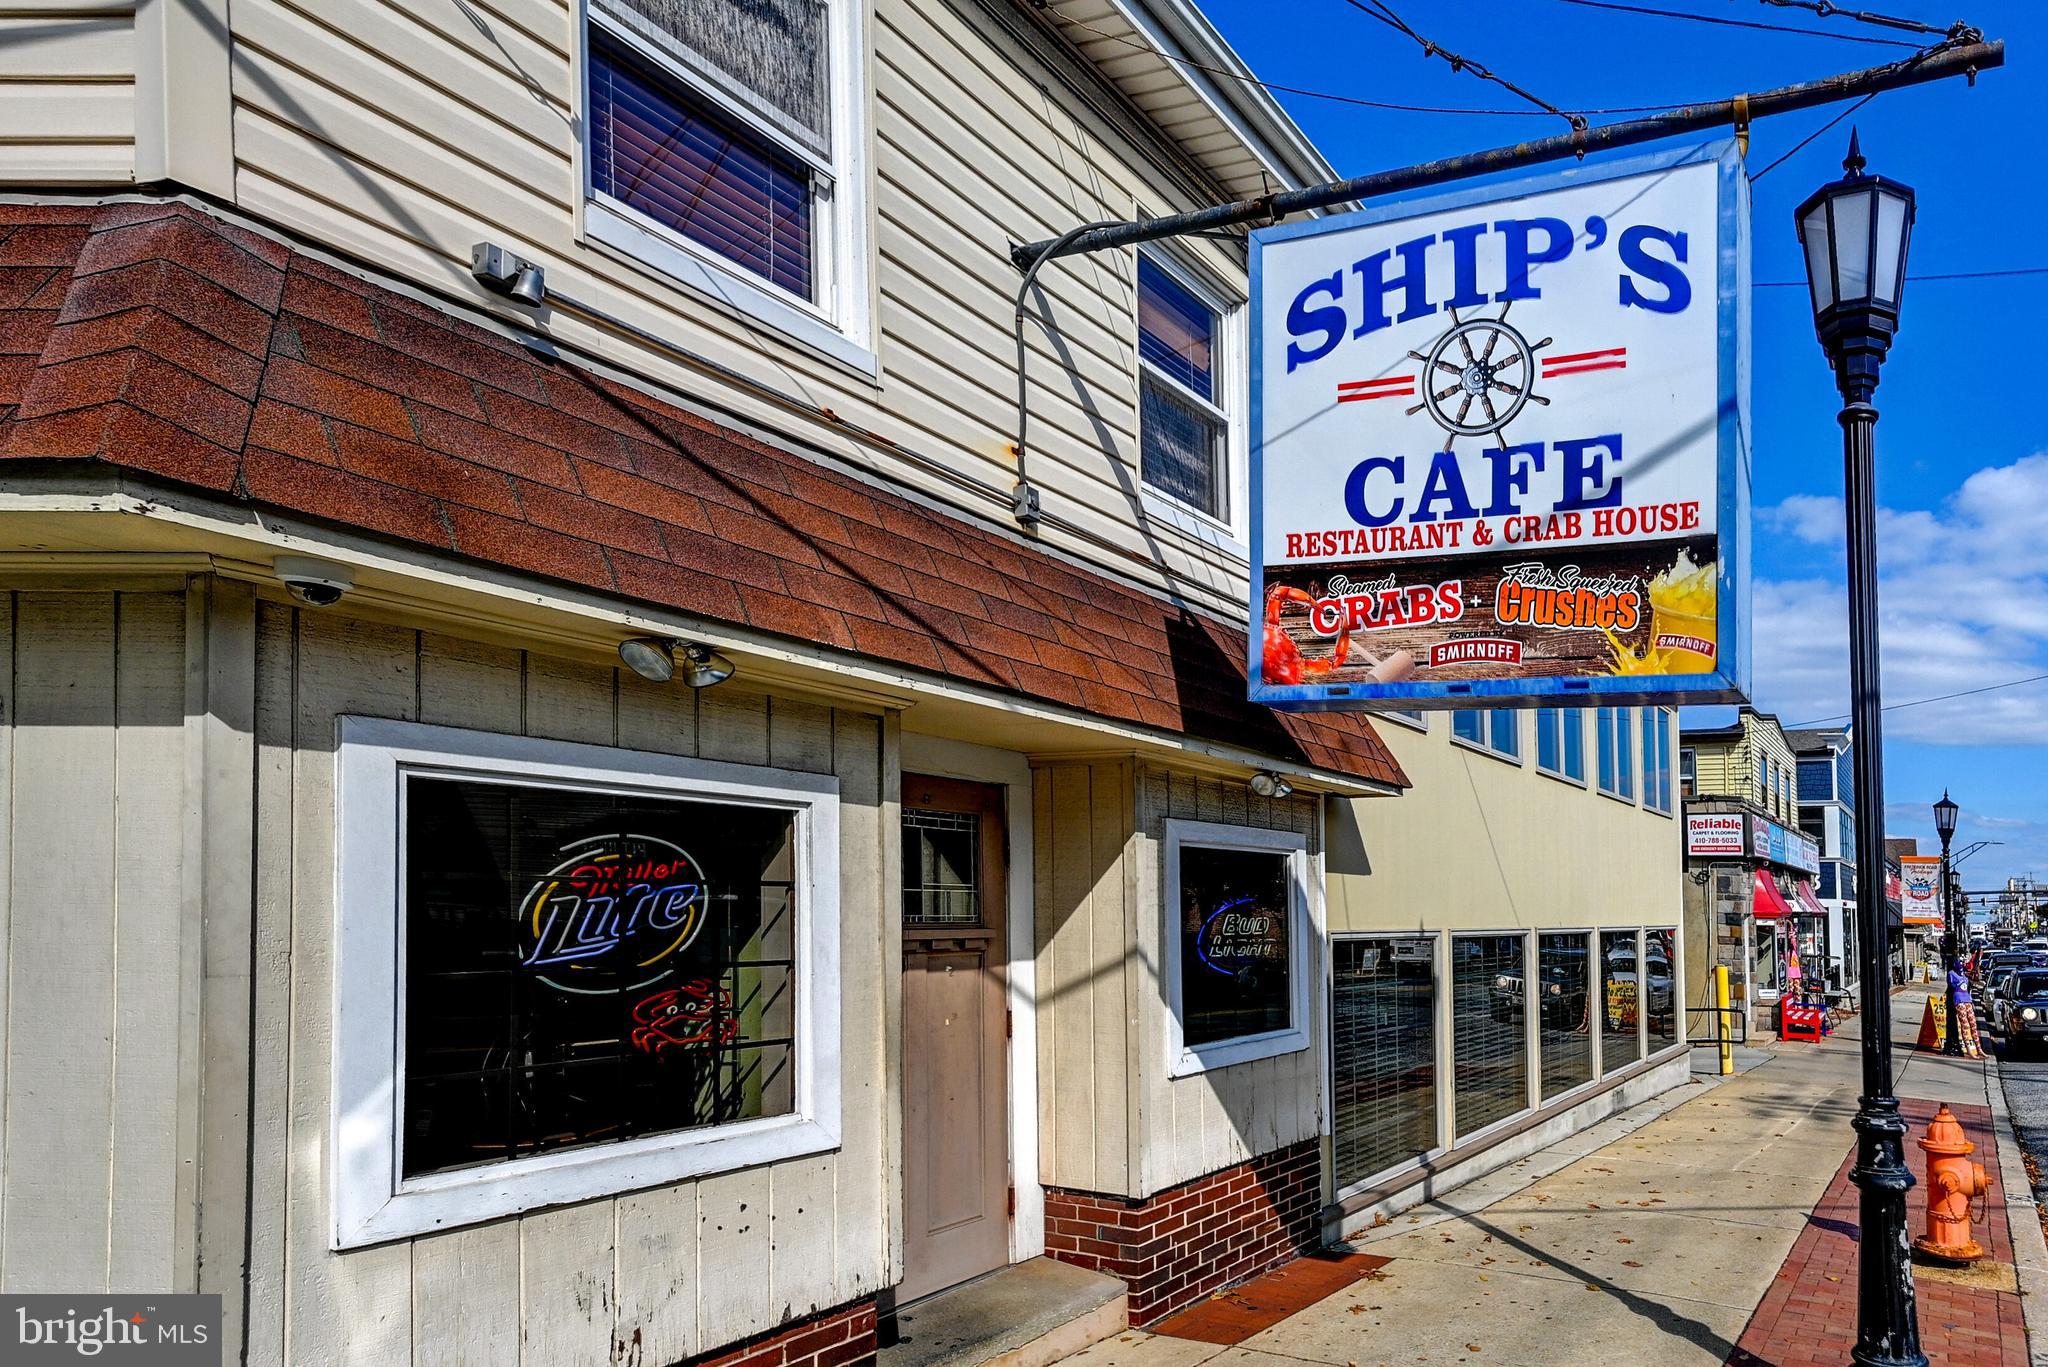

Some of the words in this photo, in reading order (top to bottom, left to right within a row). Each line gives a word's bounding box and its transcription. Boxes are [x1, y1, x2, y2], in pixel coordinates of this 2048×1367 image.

[1286, 214, 1692, 373] SHIP'S
[1344, 433, 1623, 527] CAFE
[1286, 521, 1463, 558] RESTAURANT
[1473, 521, 1493, 545] &
[1504, 512, 1581, 544] CRAB
[1592, 502, 1700, 538] HOUSE
[1328, 573, 1395, 599] Steamed
[1503, 562, 1555, 588] Fresh
[1555, 565, 1637, 598] Squeezed
[1310, 580, 1463, 637] CRABS
[1495, 577, 1640, 631] Crushes
[1437, 643, 1514, 662] SMIRNOFF
[1658, 636, 1711, 653] SMIRNOFF
[1690, 818, 1741, 830] Reliable
[1222, 914, 1269, 935] BUD
